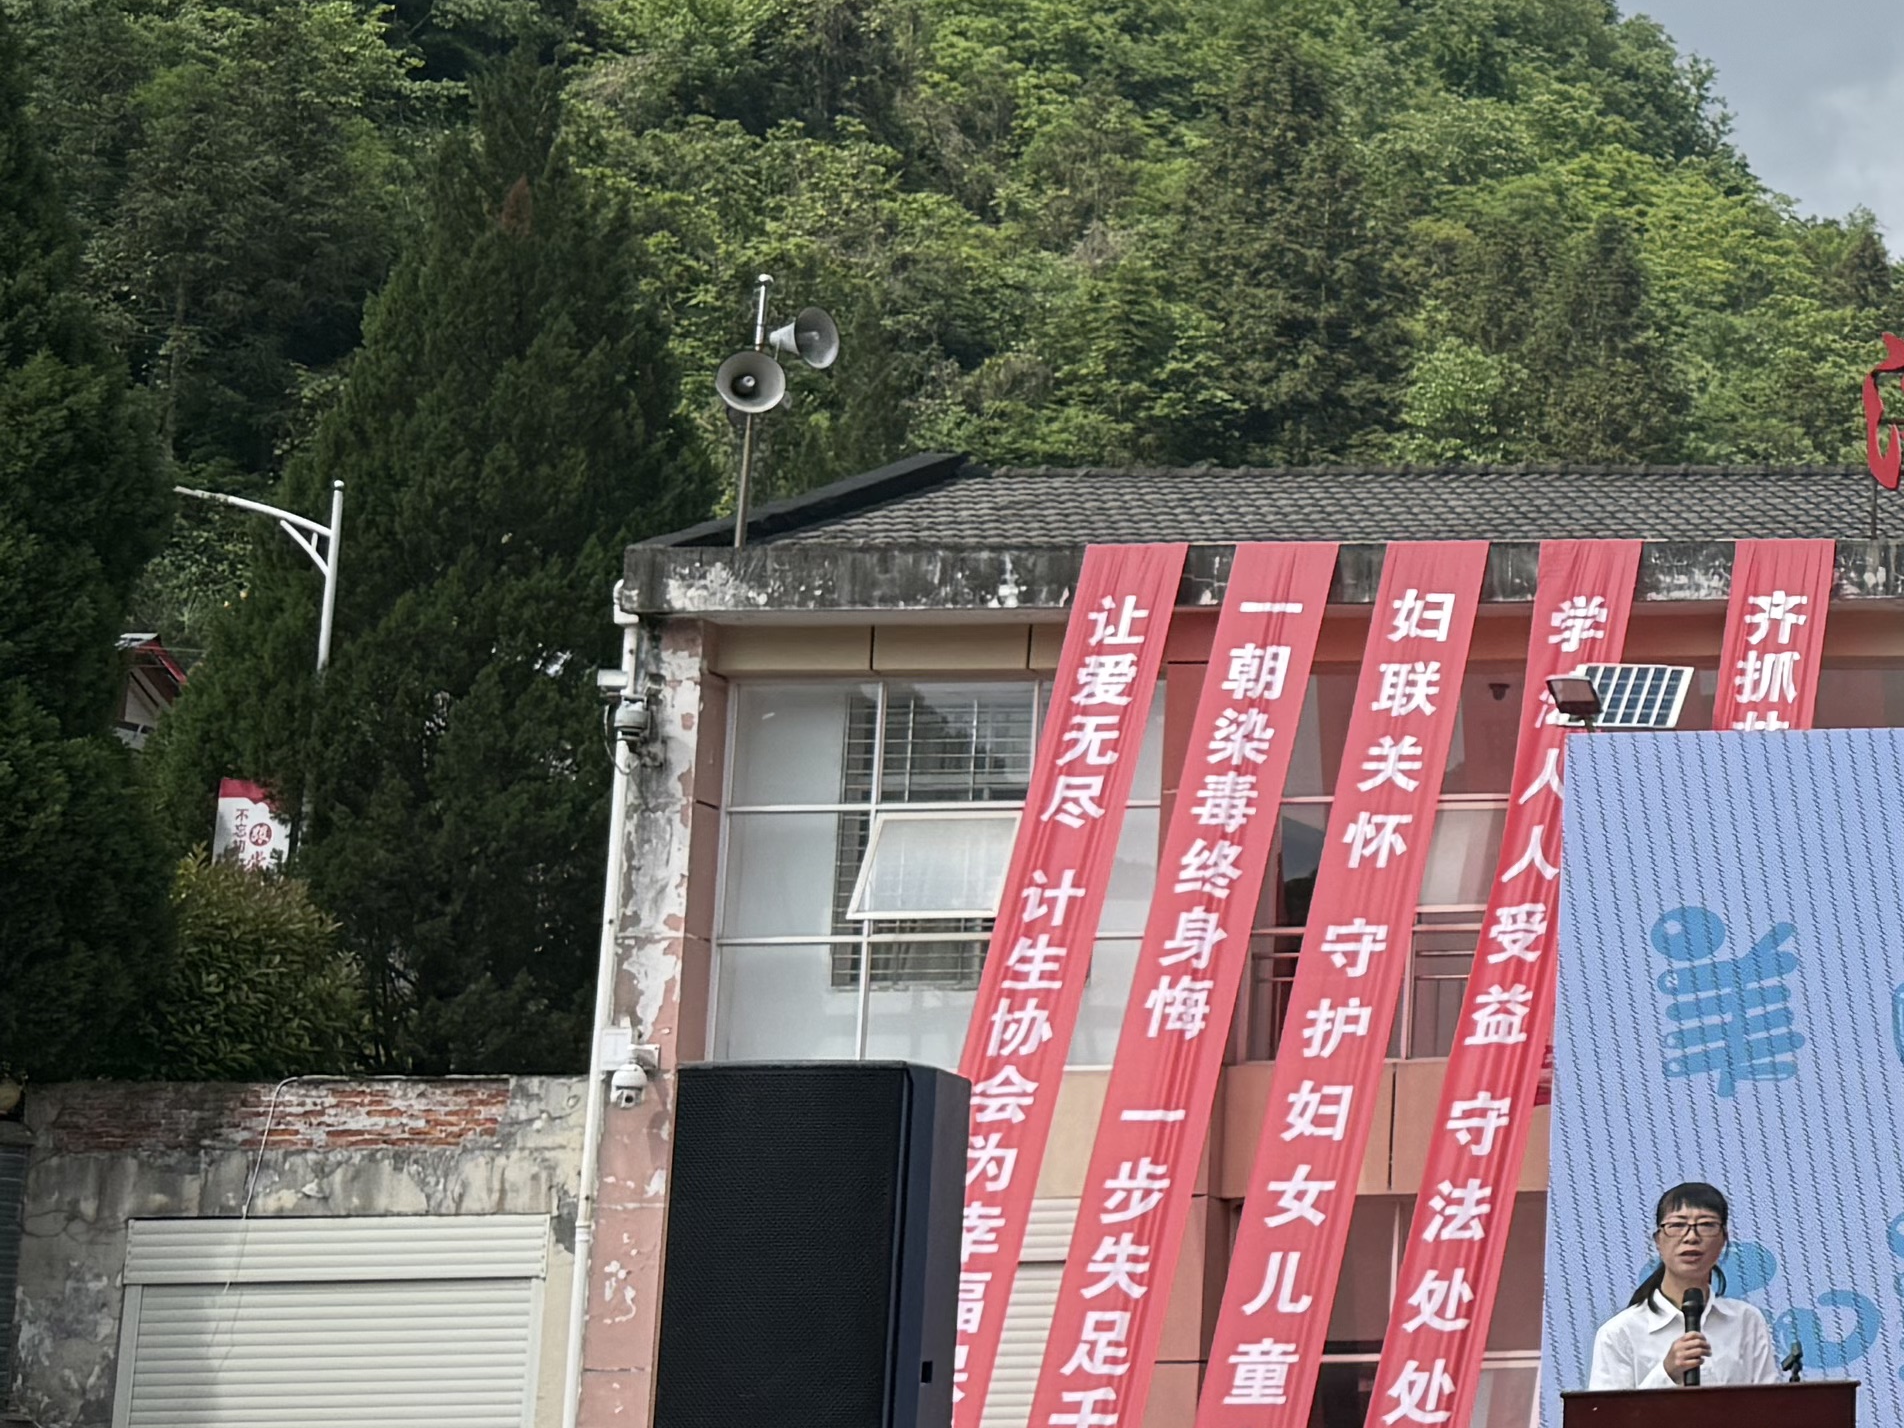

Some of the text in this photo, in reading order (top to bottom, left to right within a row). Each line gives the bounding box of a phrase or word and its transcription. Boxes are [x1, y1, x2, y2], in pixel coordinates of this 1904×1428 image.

[1041, 594, 1149, 828] 让爱无尽
[1145, 601, 1304, 1040] 一朝染毒终身悔
[1343, 588, 1457, 869] 妇联关怀
[1464, 596, 1607, 1046] 学人人受益
